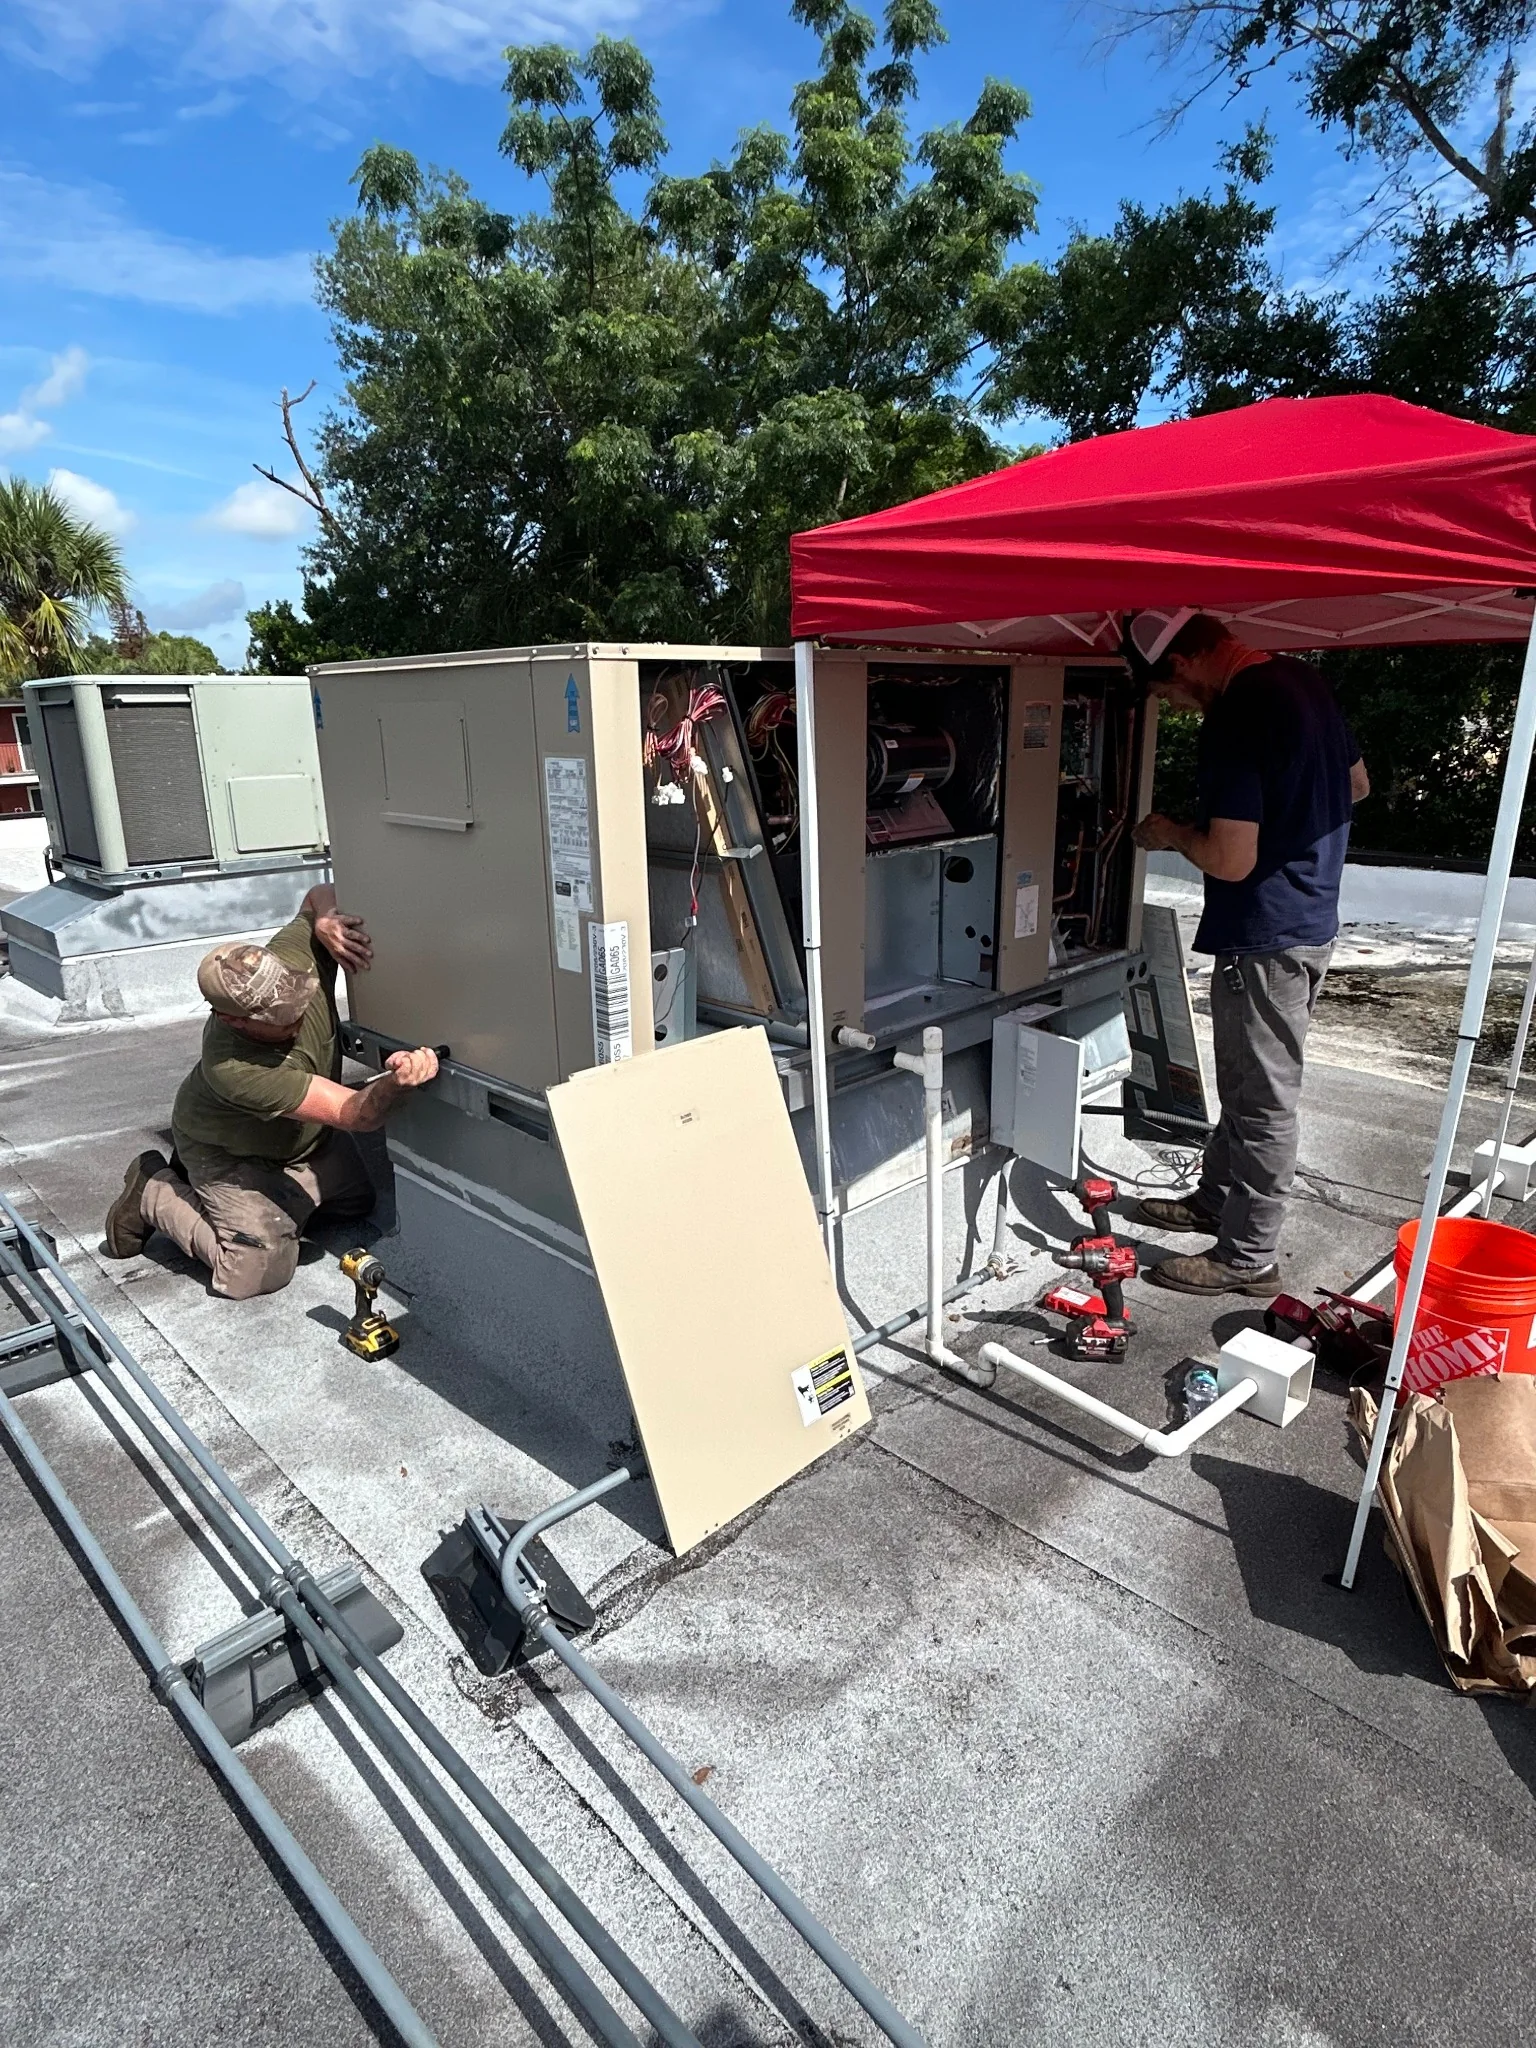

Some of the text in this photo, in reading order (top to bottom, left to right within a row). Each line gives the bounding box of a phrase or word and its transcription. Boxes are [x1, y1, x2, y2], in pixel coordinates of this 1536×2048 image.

[610, 945, 620, 976] GA065
[1411, 1324, 1450, 1352] THE
[1403, 1328, 1505, 1391] HOME
